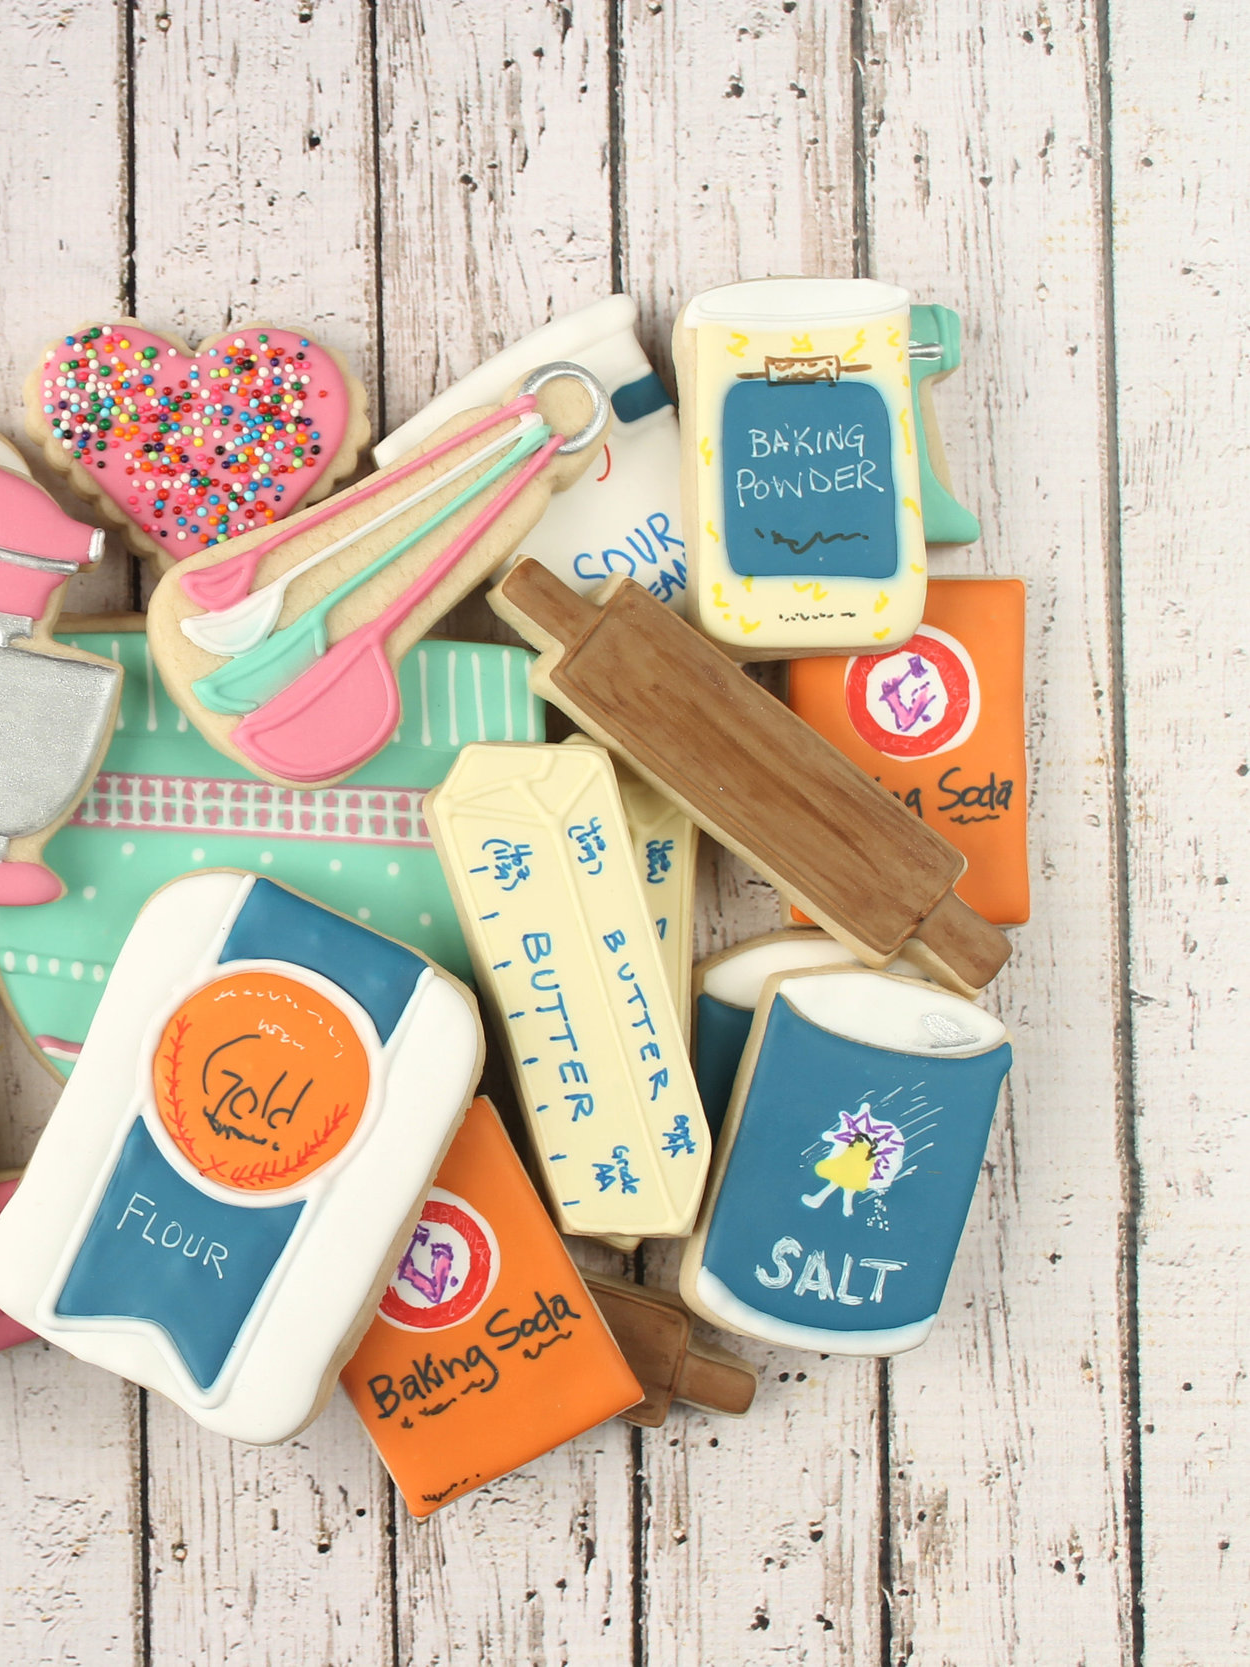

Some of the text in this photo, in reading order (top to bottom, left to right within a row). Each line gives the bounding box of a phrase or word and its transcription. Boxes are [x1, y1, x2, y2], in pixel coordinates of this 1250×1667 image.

[748, 422, 865, 457] BAKING
[736, 459, 885, 508] POWDER
[573, 512, 685, 579] SOUR
[937, 766, 1014, 812] Soda
[522, 931, 595, 1121] BUTTER
[602, 929, 669, 1101] BUTTER
[202, 1033, 314, 1130] Gold
[117, 1191, 229, 1279] FLOUR
[754, 1235, 908, 1306] SALT
[367, 1291, 581, 1419] Baking Soda
